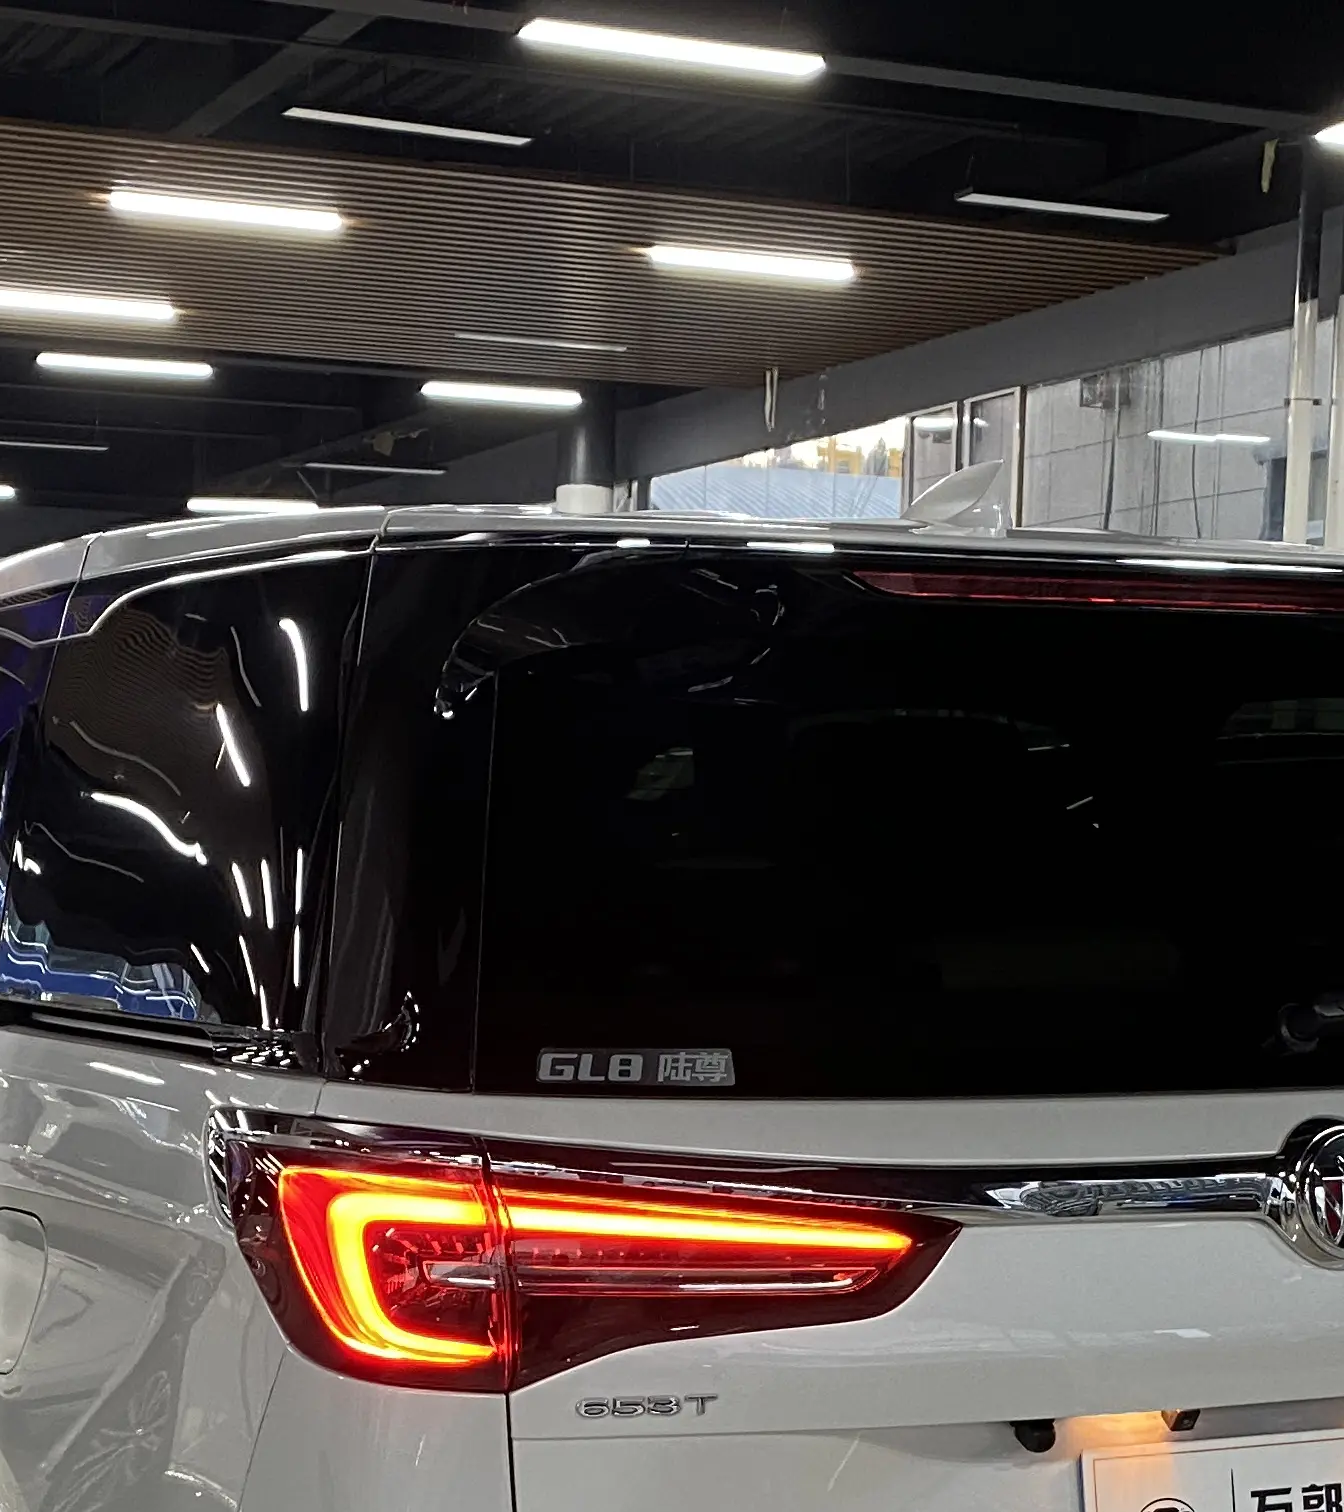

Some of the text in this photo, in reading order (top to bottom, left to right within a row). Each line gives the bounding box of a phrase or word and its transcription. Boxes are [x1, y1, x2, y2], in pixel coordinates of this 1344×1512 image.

[538, 1051, 729, 1083] GL8 陆尊
[575, 1394, 719, 1419] 653T
